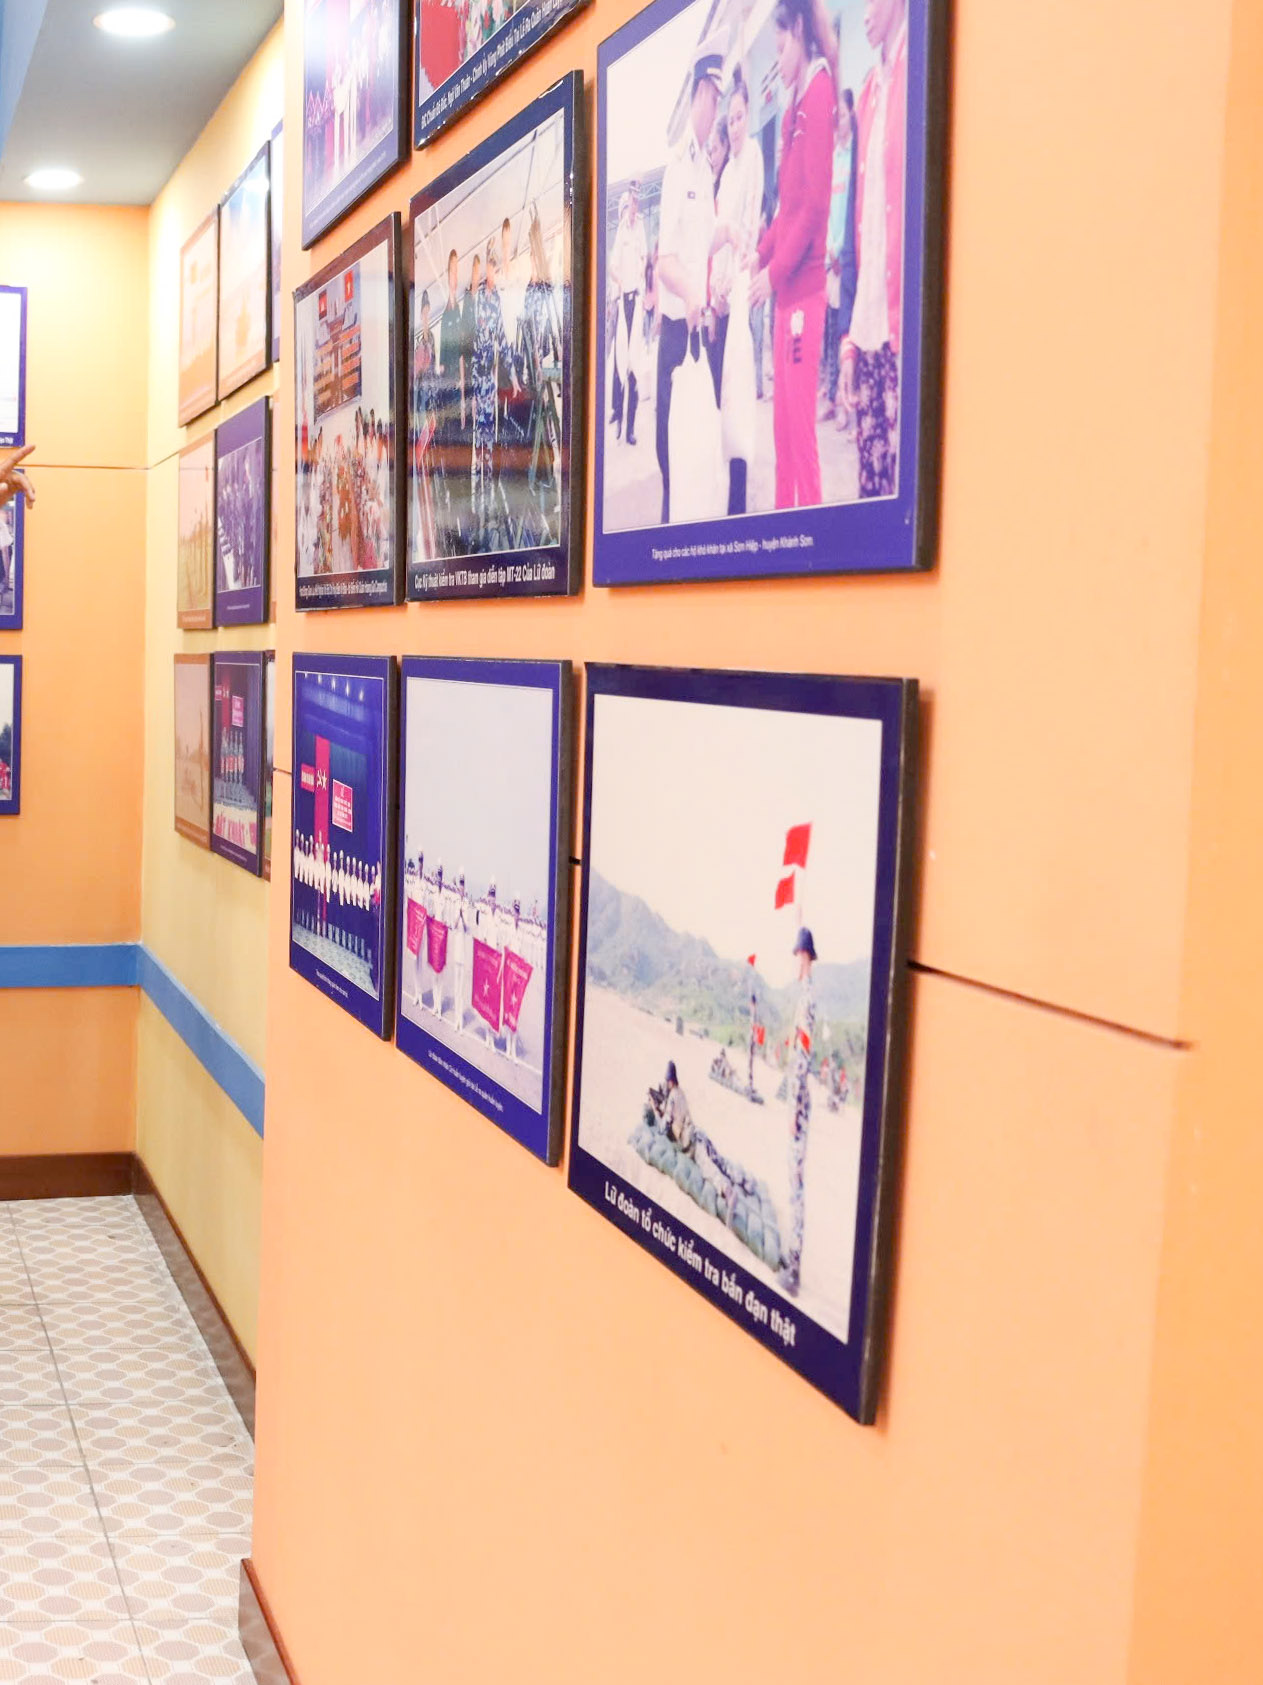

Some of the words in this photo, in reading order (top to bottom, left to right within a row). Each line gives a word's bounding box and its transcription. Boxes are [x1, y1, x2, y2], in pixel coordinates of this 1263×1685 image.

[604, 1181, 618, 1205] Lữ
[617, 1188, 640, 1223] đoàn
[641, 1207, 652, 1233] tổ
[652, 1221, 677, 1252] chức
[677, 1237, 703, 1273] kiểm
[704, 1259, 720, 1287] tra
[721, 1270, 744, 1307] bắn
[745, 1290, 768, 1325] đạn
[770, 1308, 797, 1348] thật
